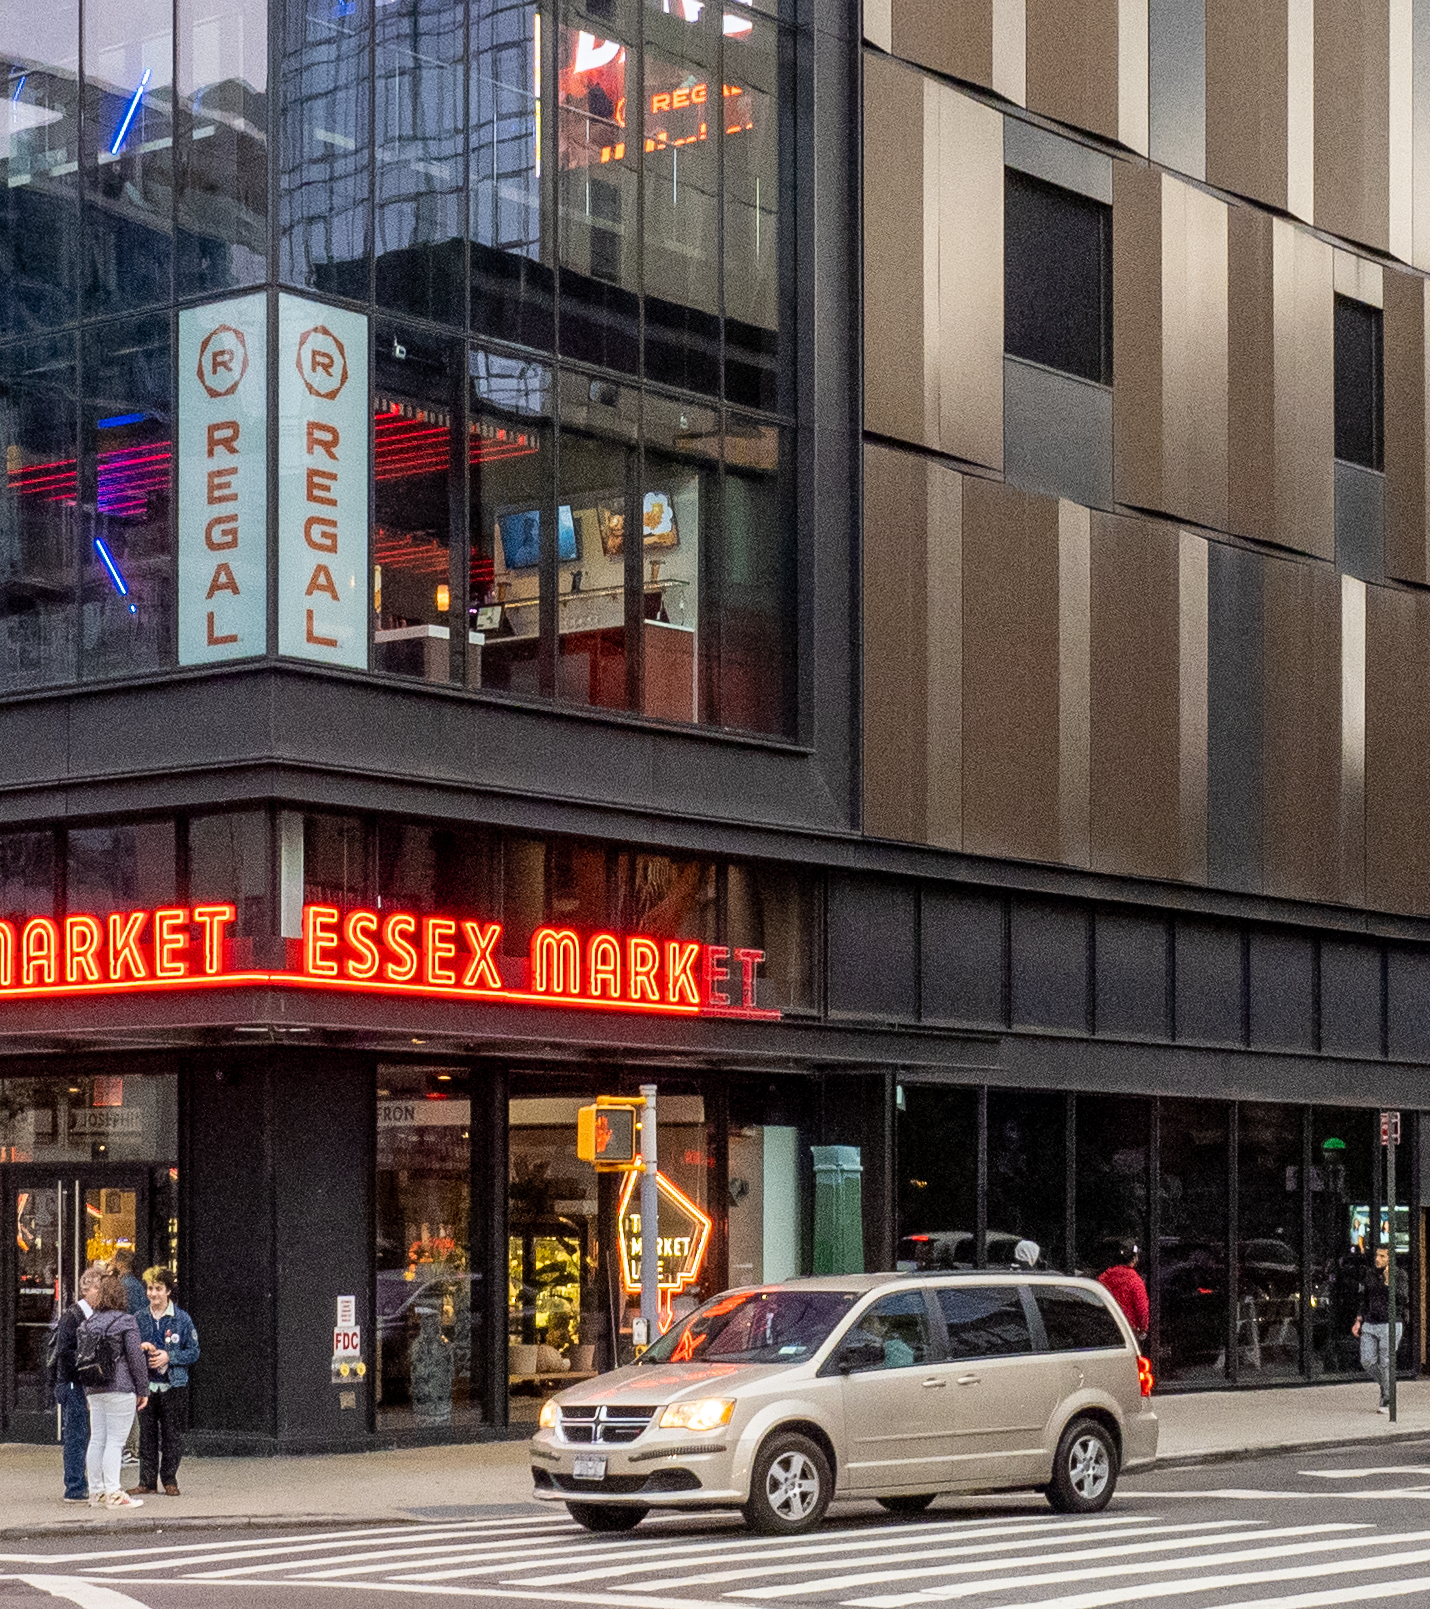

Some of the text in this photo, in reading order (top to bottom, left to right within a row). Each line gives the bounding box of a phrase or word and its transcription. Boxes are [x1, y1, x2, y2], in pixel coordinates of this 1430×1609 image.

[204, 420, 240, 647] REGAL
[304, 420, 340, 648] REGAL
[305, 906, 767, 1007] ESSEX MARKET
[631, 1237, 690, 1256] MRKET
[335, 1332, 359, 1350] FDC
